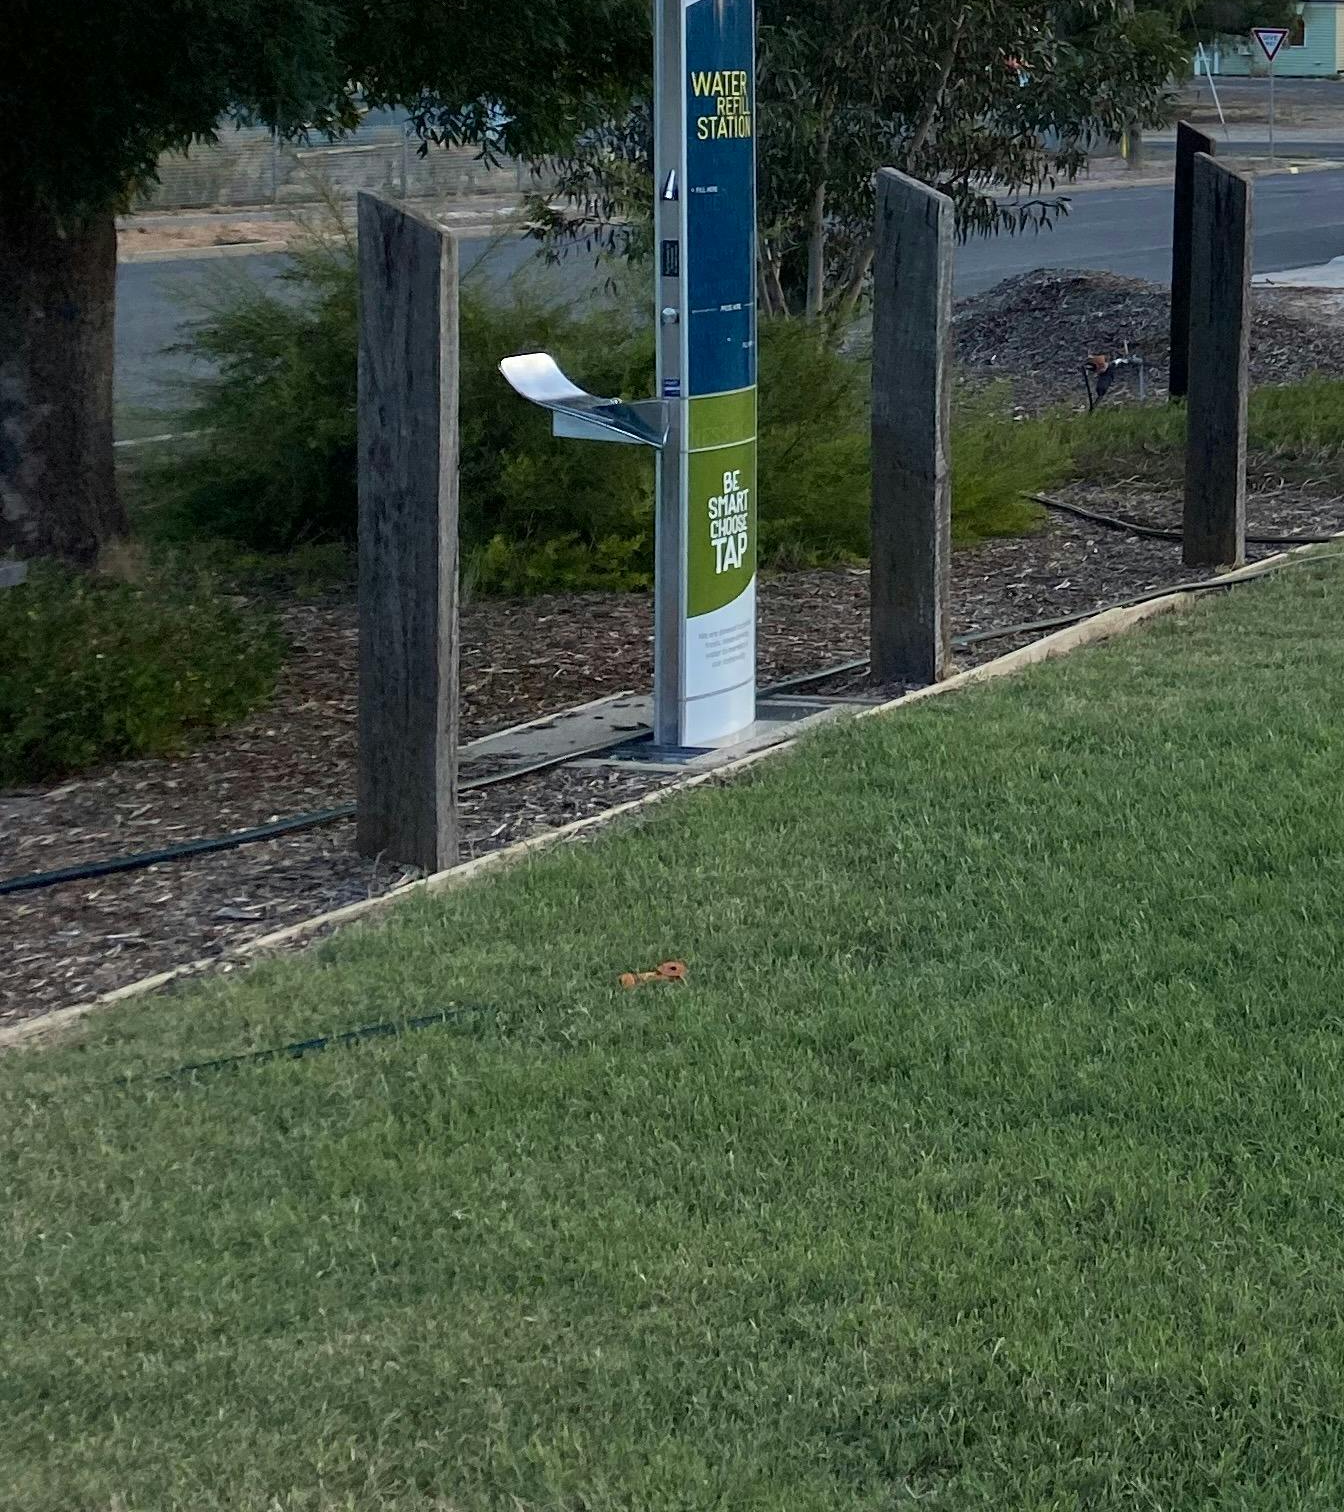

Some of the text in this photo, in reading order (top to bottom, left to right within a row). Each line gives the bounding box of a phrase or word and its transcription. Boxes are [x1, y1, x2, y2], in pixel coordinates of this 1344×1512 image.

[691, 71, 747, 97] WATER
[717, 97, 751, 115] REFILL
[697, 115, 751, 140] STATION
[723, 469, 741, 495] BE
[708, 488, 749, 520] SMART
[710, 512, 748, 539] CHOOSE
[711, 530, 748, 574] TAP
